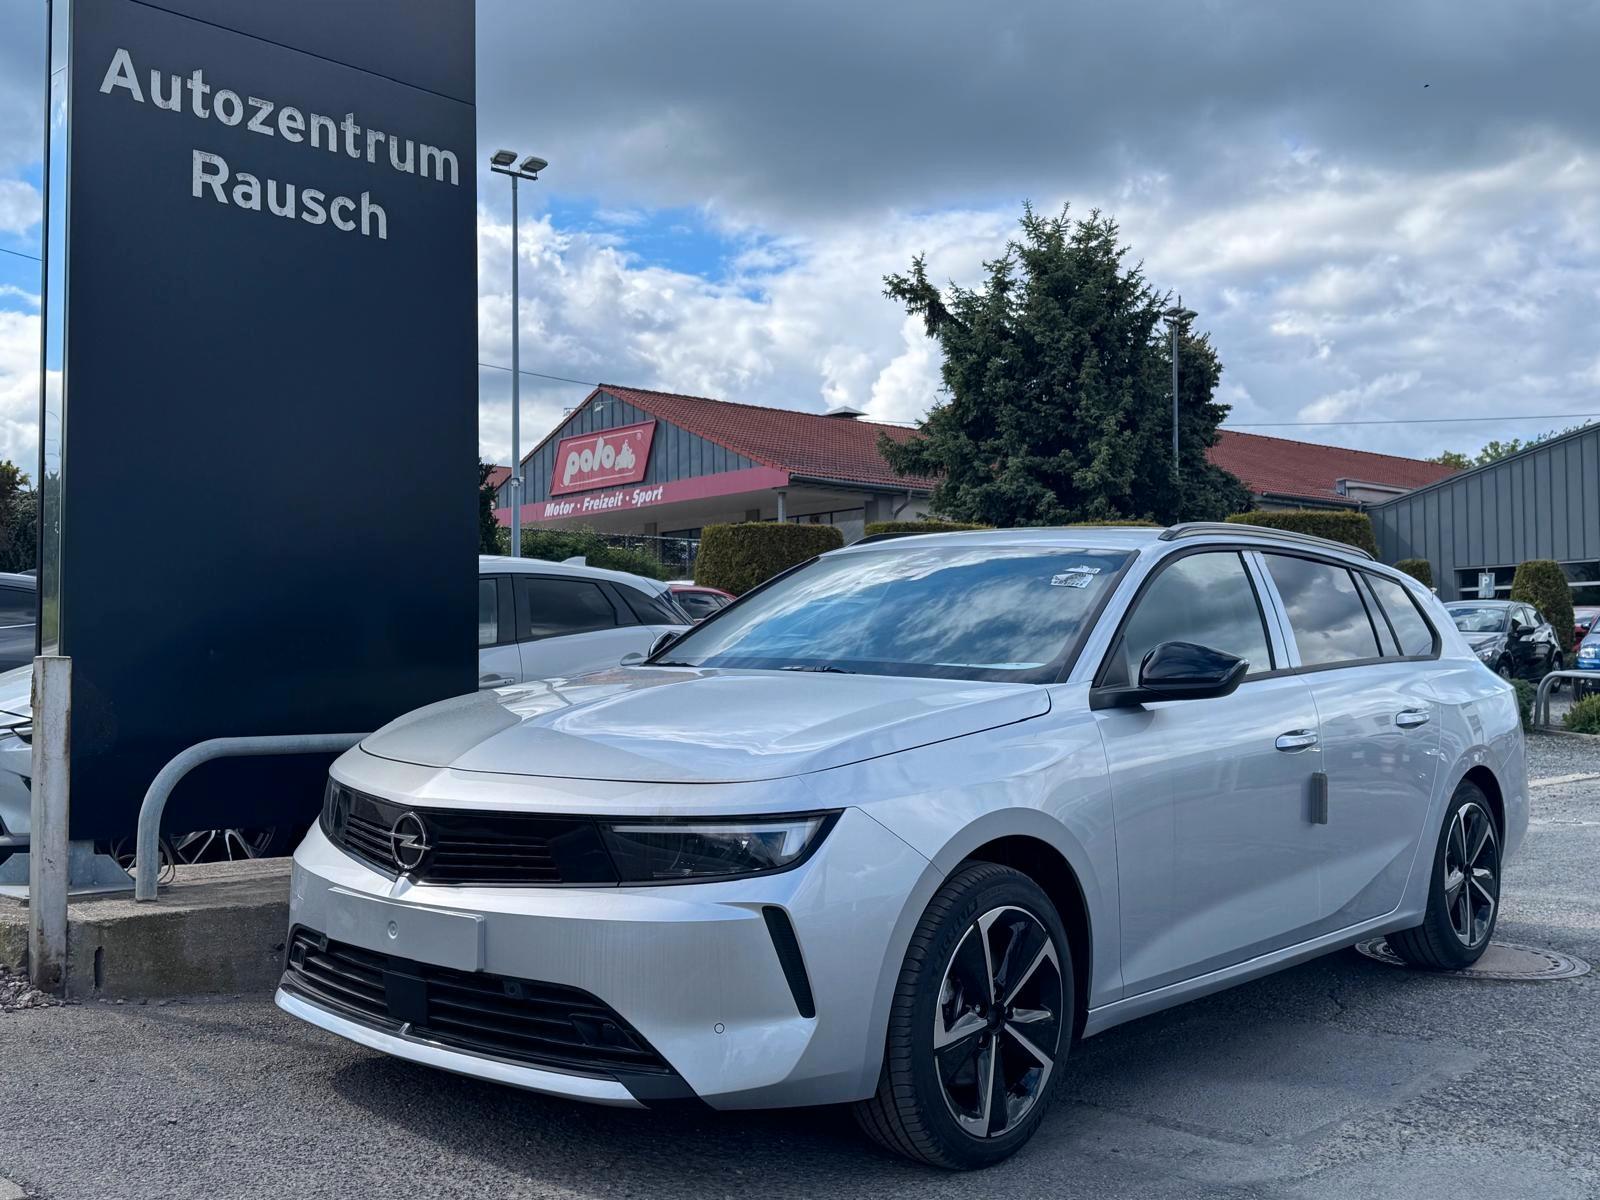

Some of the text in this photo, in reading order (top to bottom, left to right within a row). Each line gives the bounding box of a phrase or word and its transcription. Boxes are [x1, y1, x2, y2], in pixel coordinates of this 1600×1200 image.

[100, 48, 460, 186] Autozentrum
[192, 149, 388, 240] Rausch
[563, 436, 615, 486] polo
[544, 486, 663, 518] Motor Freizeit Sport
[1482, 577, 1490, 588] P
